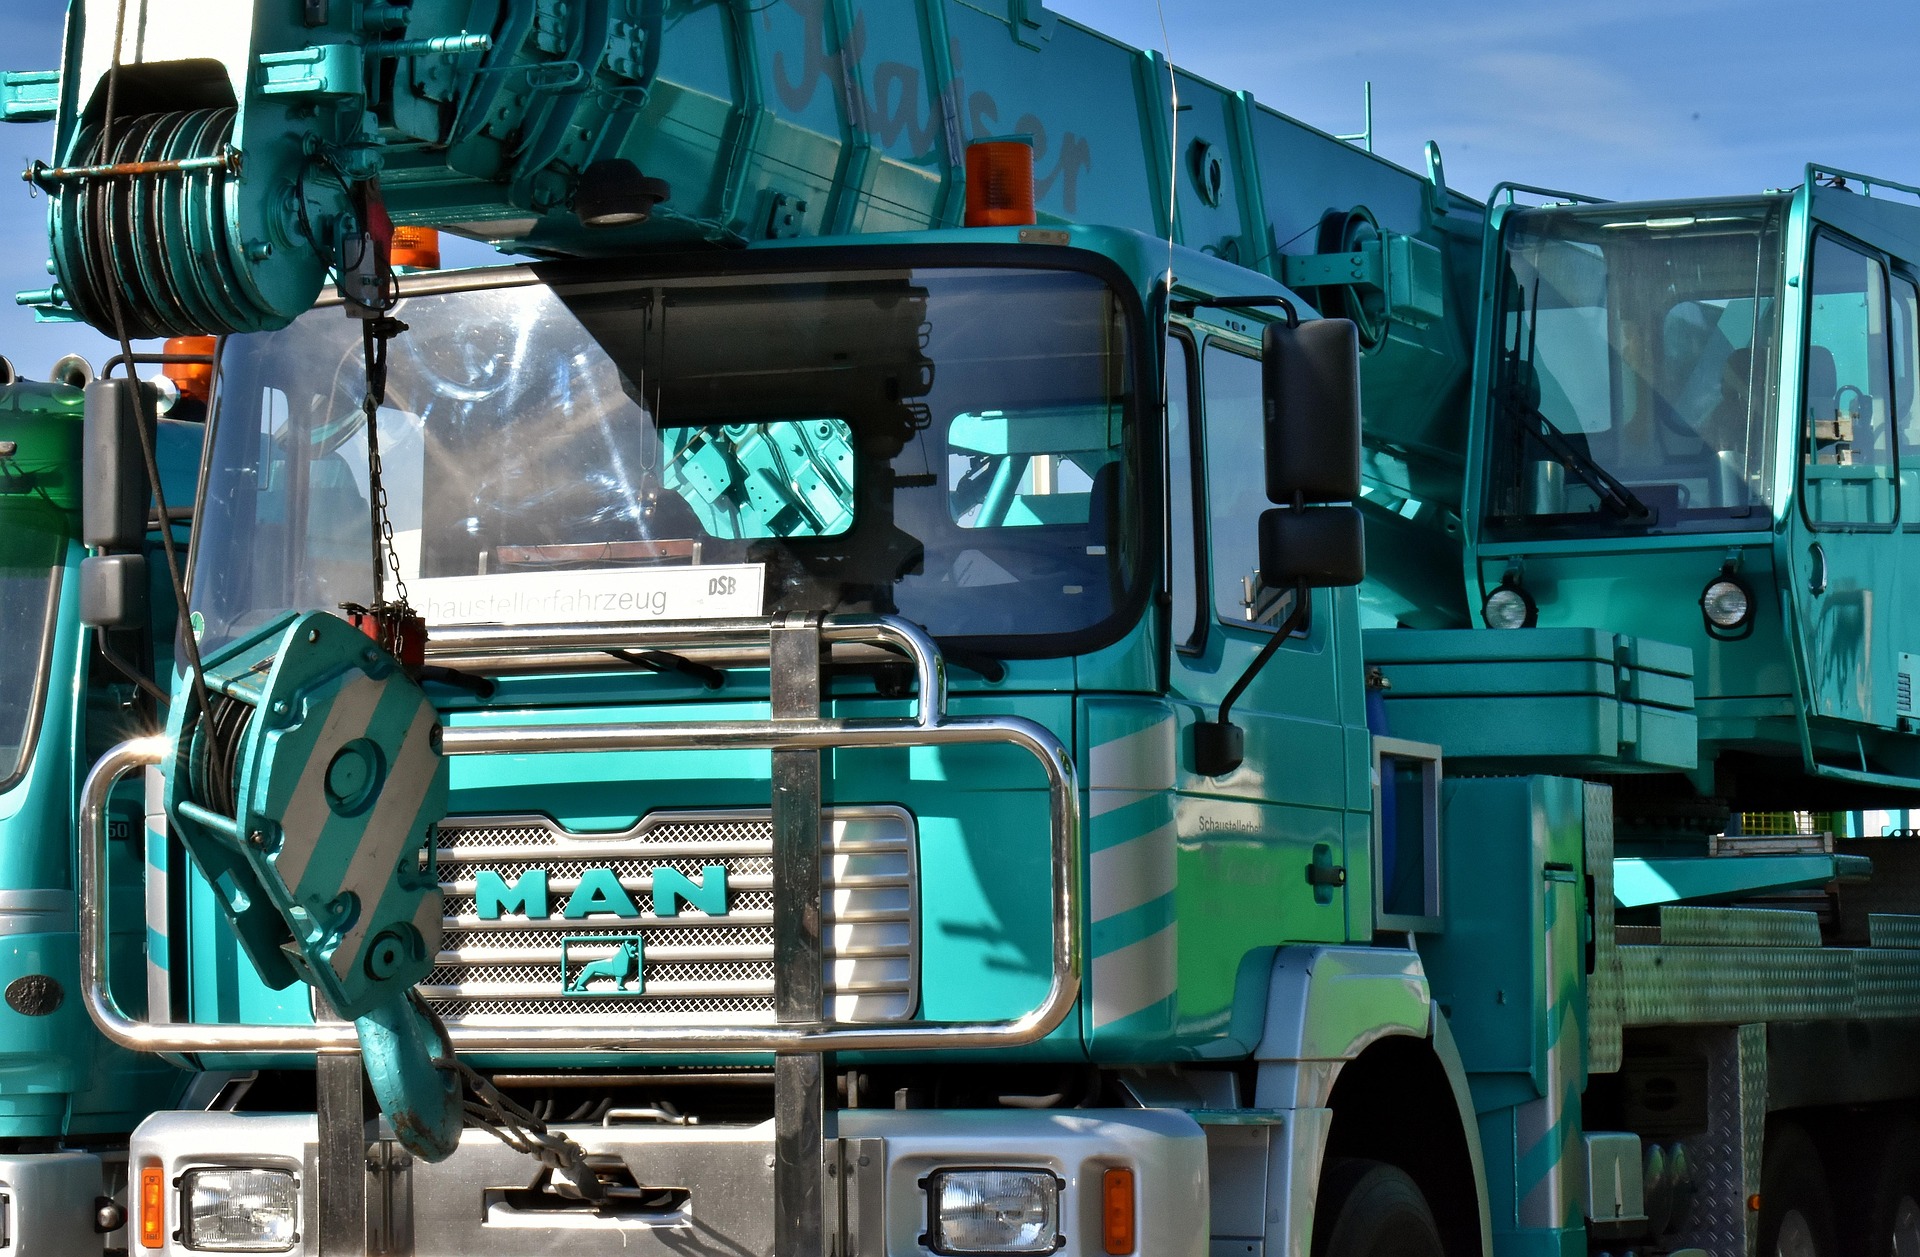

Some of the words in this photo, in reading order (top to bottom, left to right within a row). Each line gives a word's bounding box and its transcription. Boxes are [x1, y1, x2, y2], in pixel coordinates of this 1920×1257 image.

[708, 575, 737, 596] DSB
[413, 588, 667, 618] chaustellerfahrzeug
[475, 865, 729, 920] MAN
